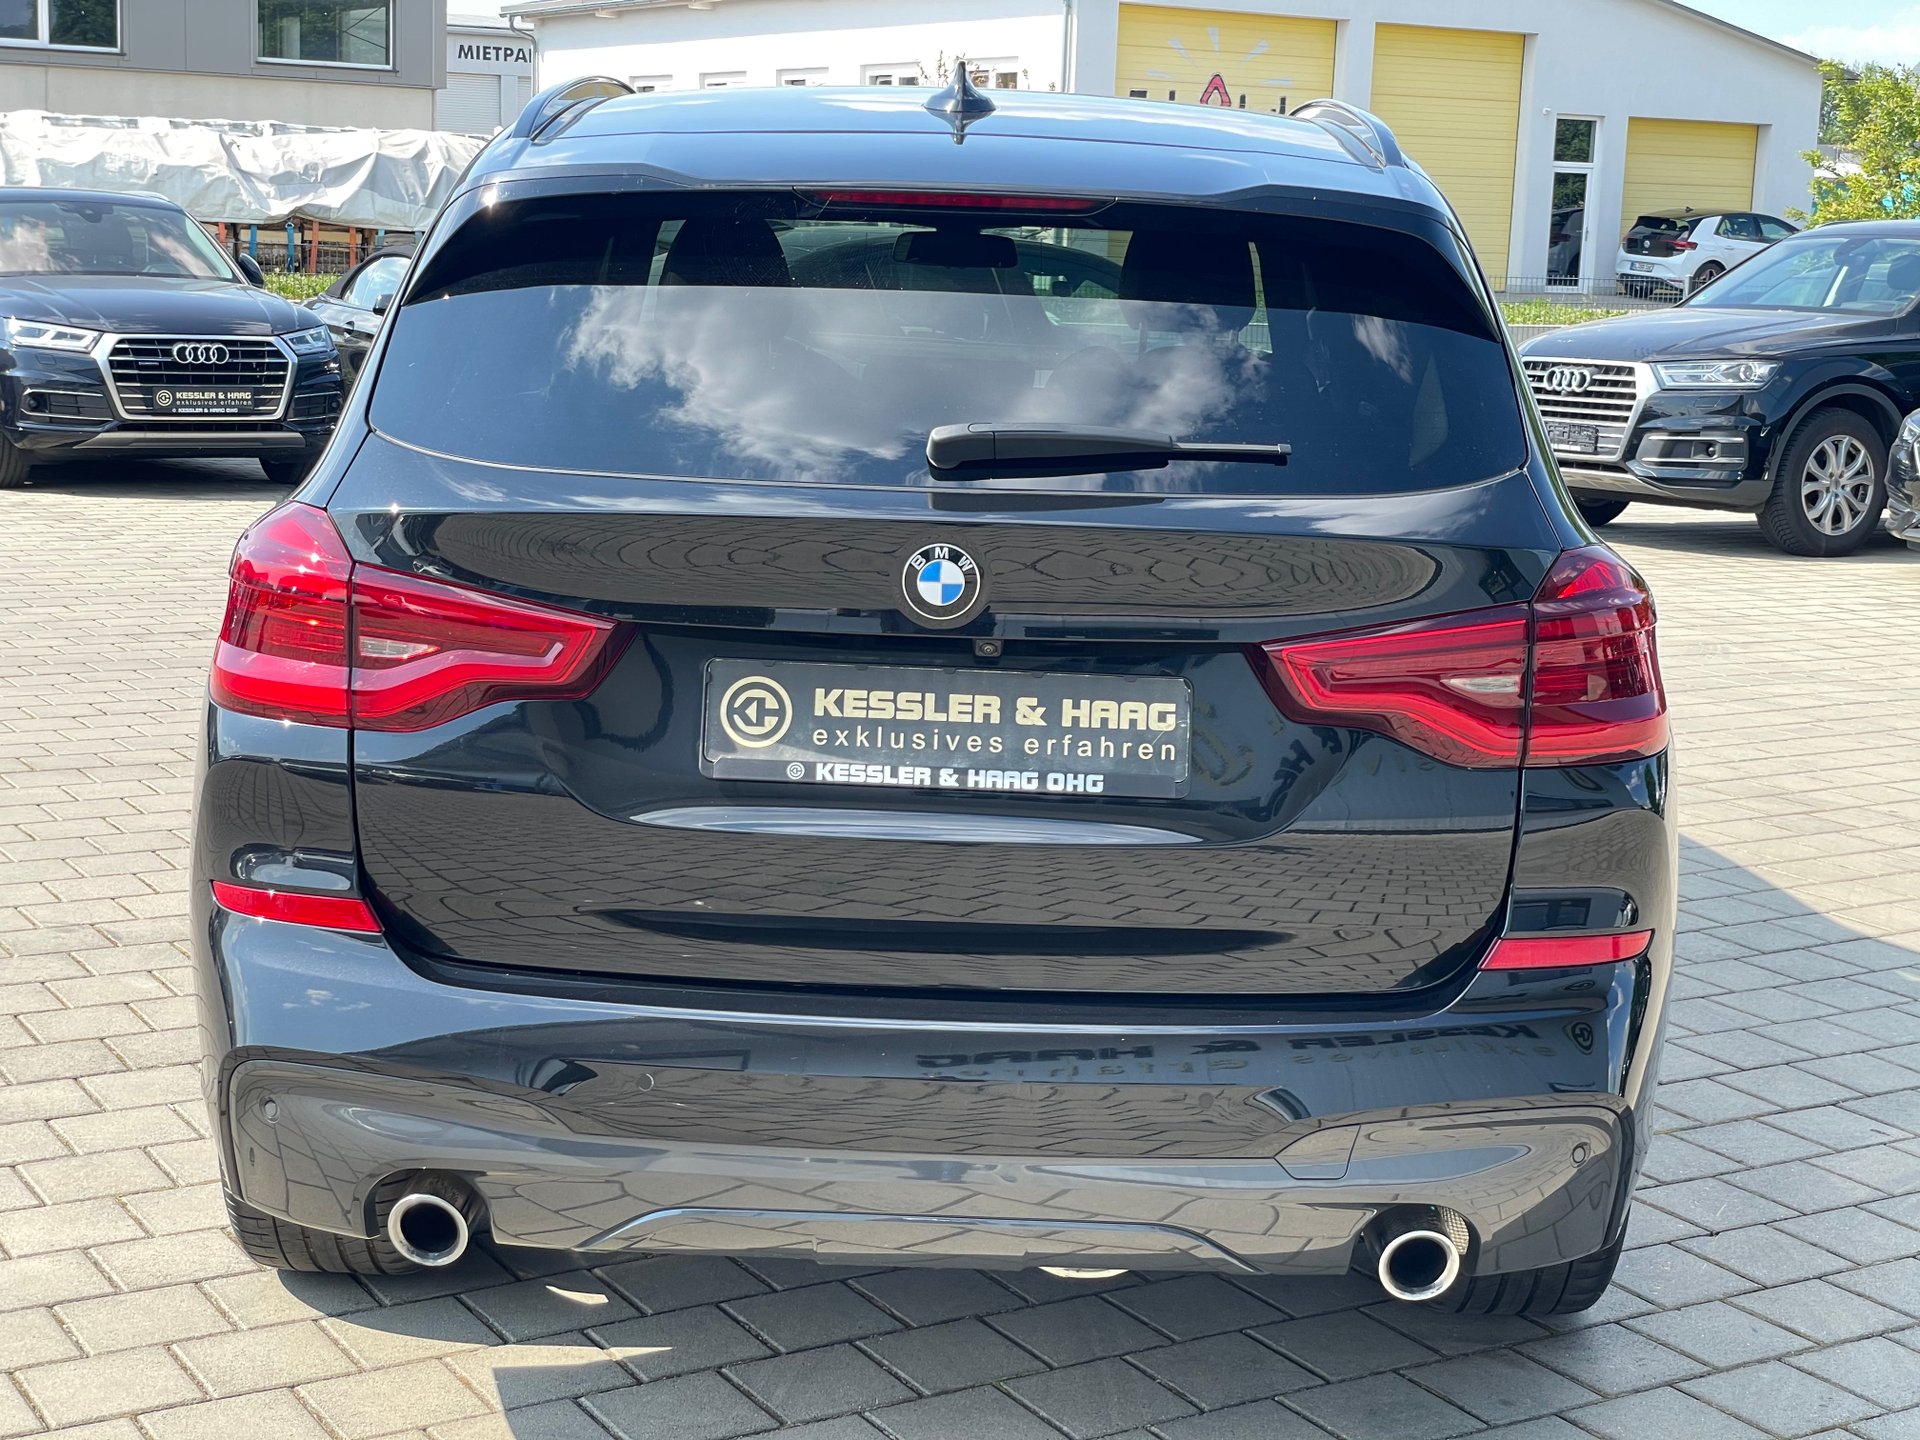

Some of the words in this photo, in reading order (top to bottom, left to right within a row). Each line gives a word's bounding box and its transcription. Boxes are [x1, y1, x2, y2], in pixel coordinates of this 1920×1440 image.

[457, 44, 532, 63] MIETPA
[911, 546, 973, 571] BMW
[814, 687, 1000, 724] KESSLER
[1015, 696, 1048, 727] &
[1061, 698, 1177, 732] HAAG
[812, 725, 1003, 753] exklusives
[1024, 734, 1176, 761] erfahren
[815, 763, 931, 786] KESSLER
[938, 767, 960, 787] &
[967, 768, 1039, 790] HAAG
[1046, 772, 1105, 793] OHG
